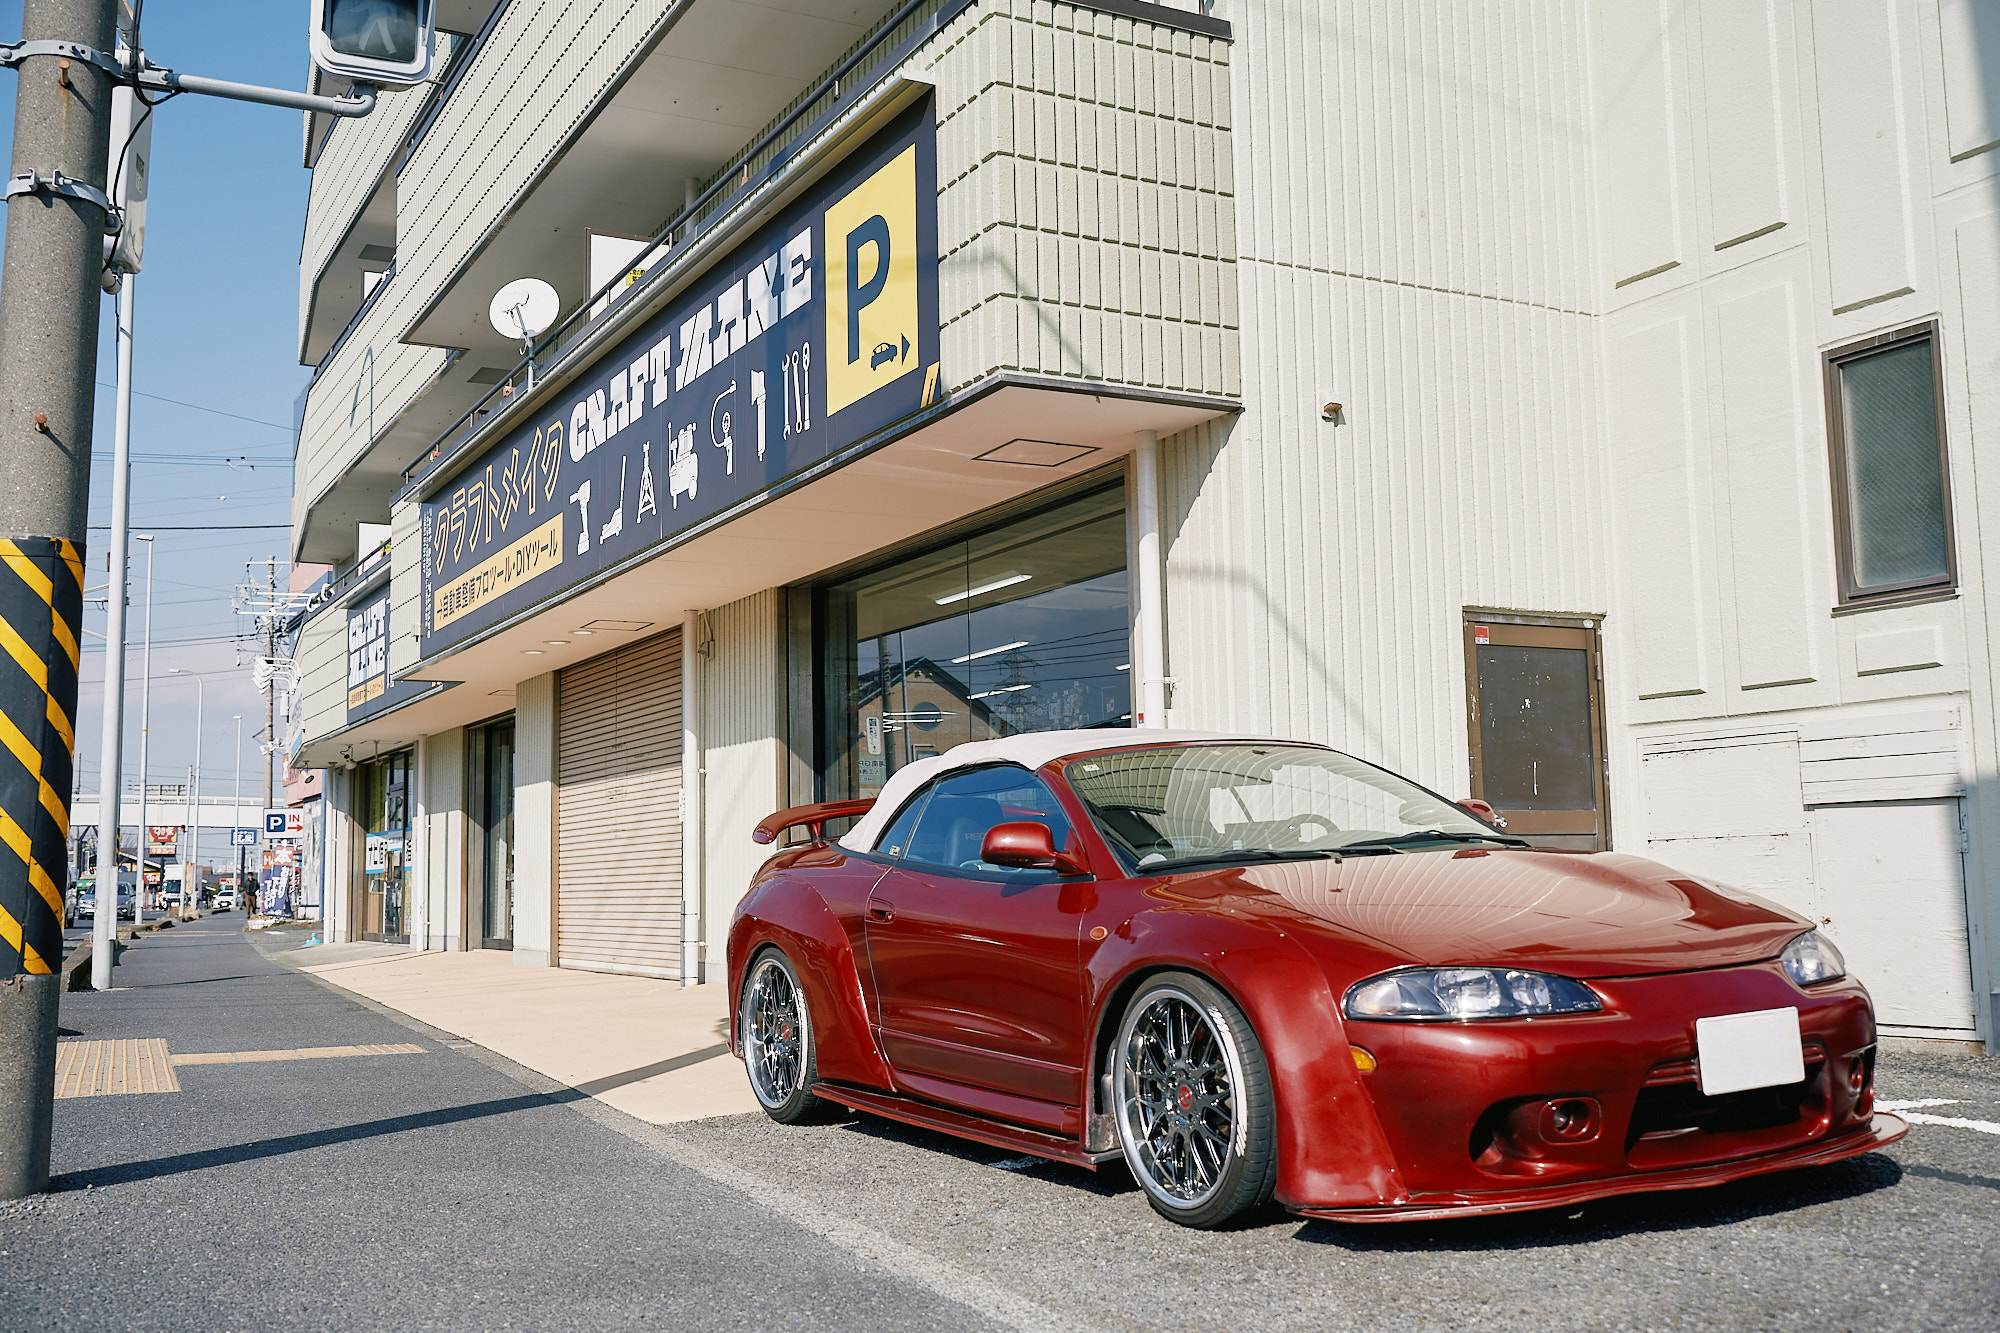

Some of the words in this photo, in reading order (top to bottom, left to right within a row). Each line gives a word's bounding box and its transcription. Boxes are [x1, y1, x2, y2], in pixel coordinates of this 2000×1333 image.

[568, 334, 671, 463] CRAFT
[675, 226, 812, 393] MAKE
[846, 214, 891, 366] P
[434, 420, 563, 575] クラフトメイク
[270, 816, 282, 830] P
[288, 814, 300, 823] IN
